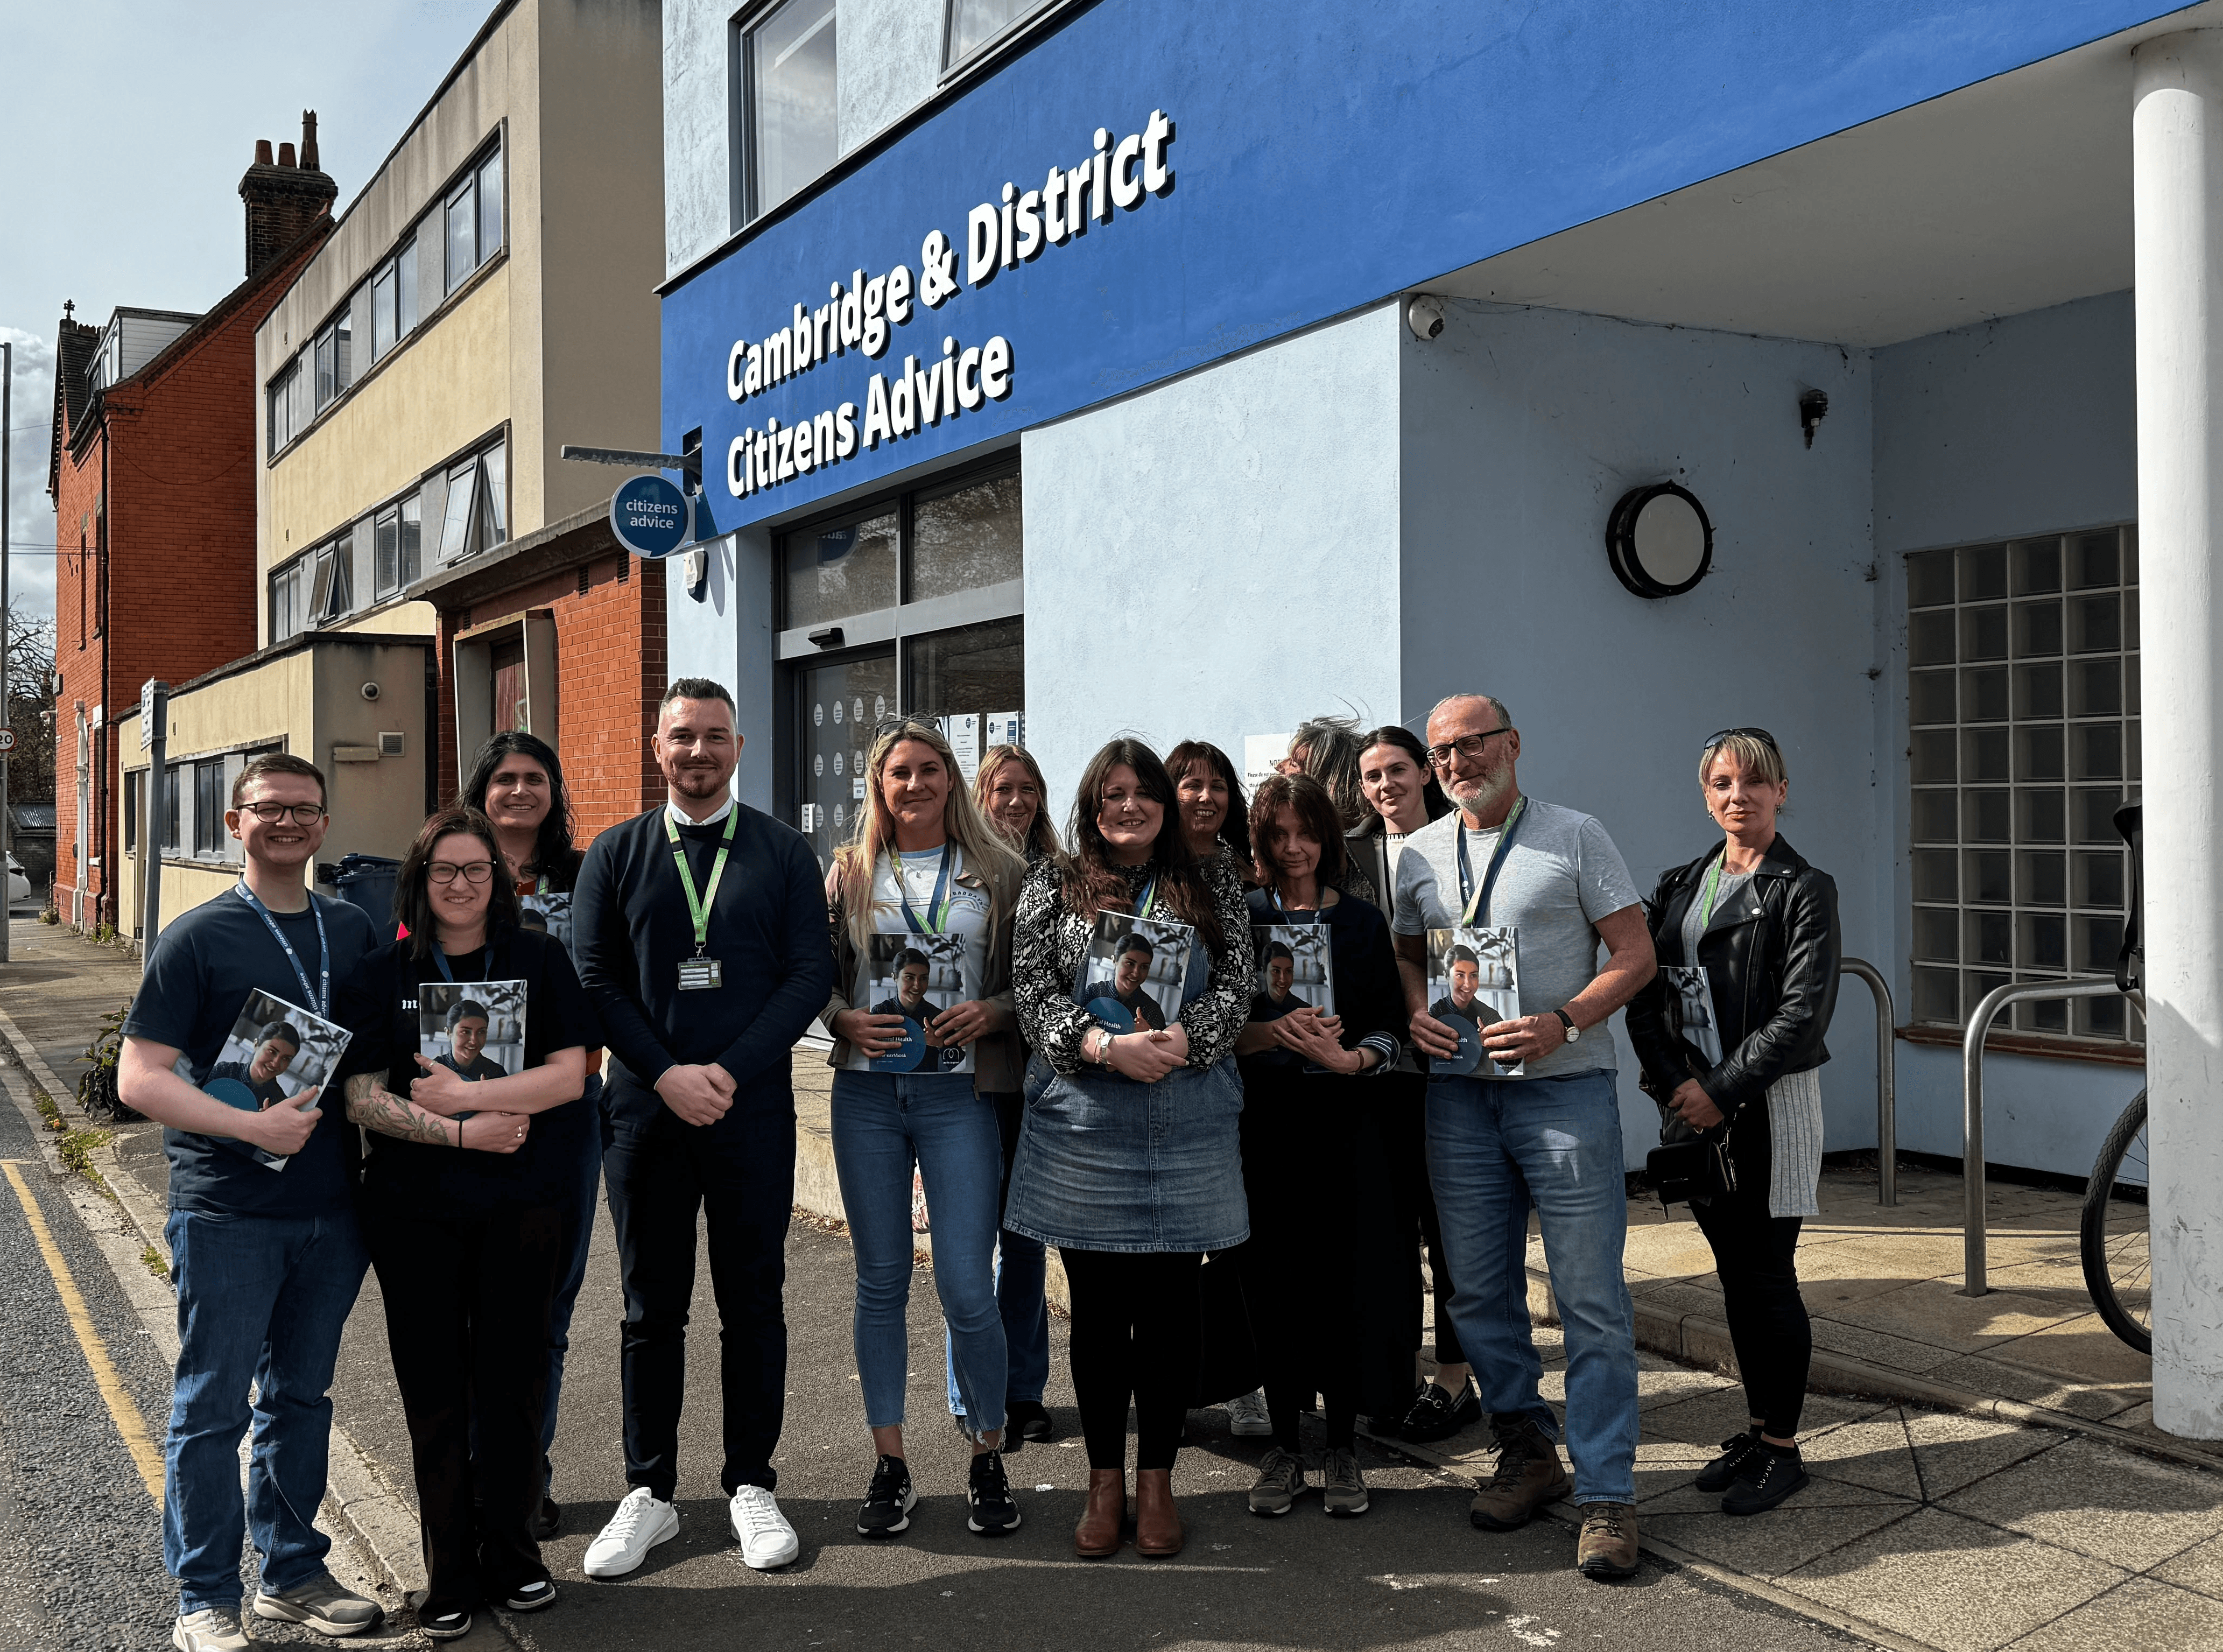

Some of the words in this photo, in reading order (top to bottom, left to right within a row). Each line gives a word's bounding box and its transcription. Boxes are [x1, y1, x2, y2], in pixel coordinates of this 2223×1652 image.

[727, 269, 910, 401] Cambridge
[920, 230, 958, 306] &
[968, 109, 1169, 285] District
[727, 402, 855, 497] Citizens
[862, 335, 1008, 447] Advice
[625, 499, 678, 515] citizens
[630, 515, 674, 529] advice
[299, 972, 310, 990] advice
[307, 987, 318, 1011] citizens
[1103, 1020, 1121, 1030] Health
